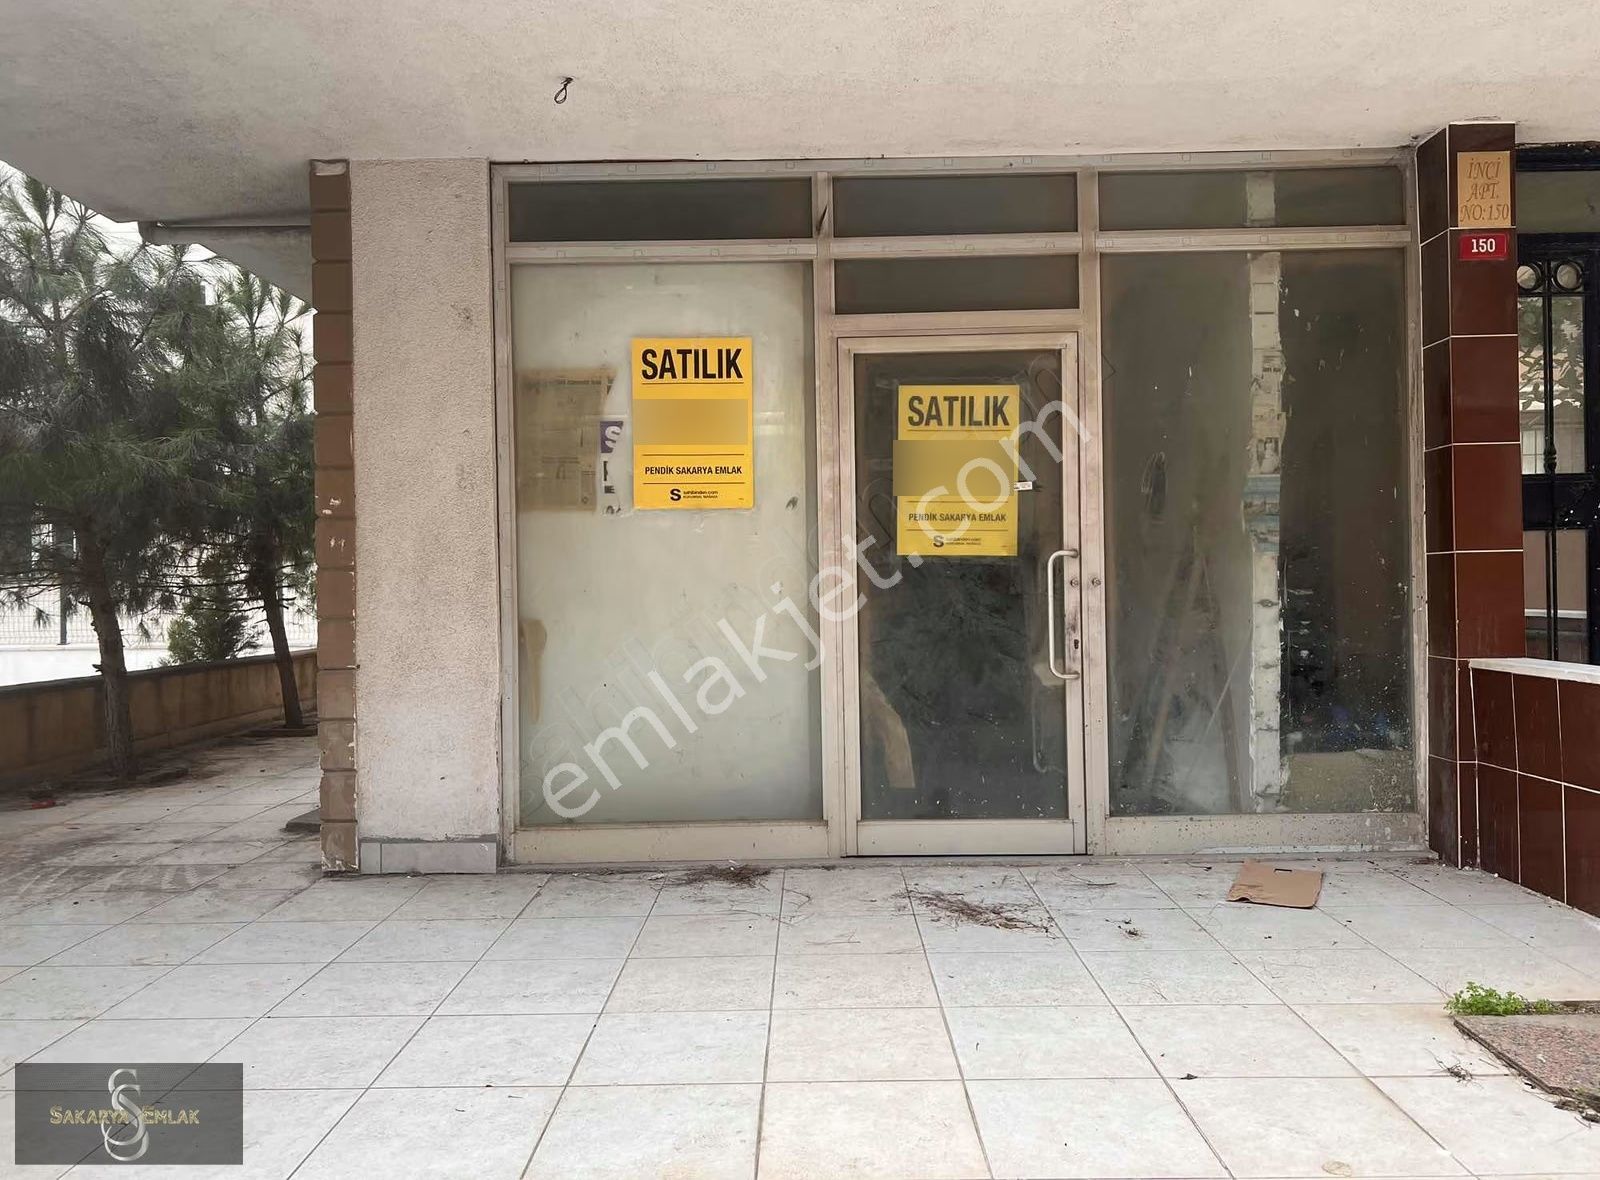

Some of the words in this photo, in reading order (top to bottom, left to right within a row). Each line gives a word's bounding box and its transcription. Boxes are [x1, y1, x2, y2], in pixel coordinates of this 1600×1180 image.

[1471, 238, 1496, 253] 150
[641, 348, 743, 380] SATILIK
[907, 395, 1011, 427] SATILIK
[644, 464, 674, 475] PENDİK
[675, 466, 713, 475] SAKARYA
[714, 465, 743, 475] EMLAK
[939, 513, 977, 522] SAKARYA
[978, 513, 1007, 522] EMLAK
